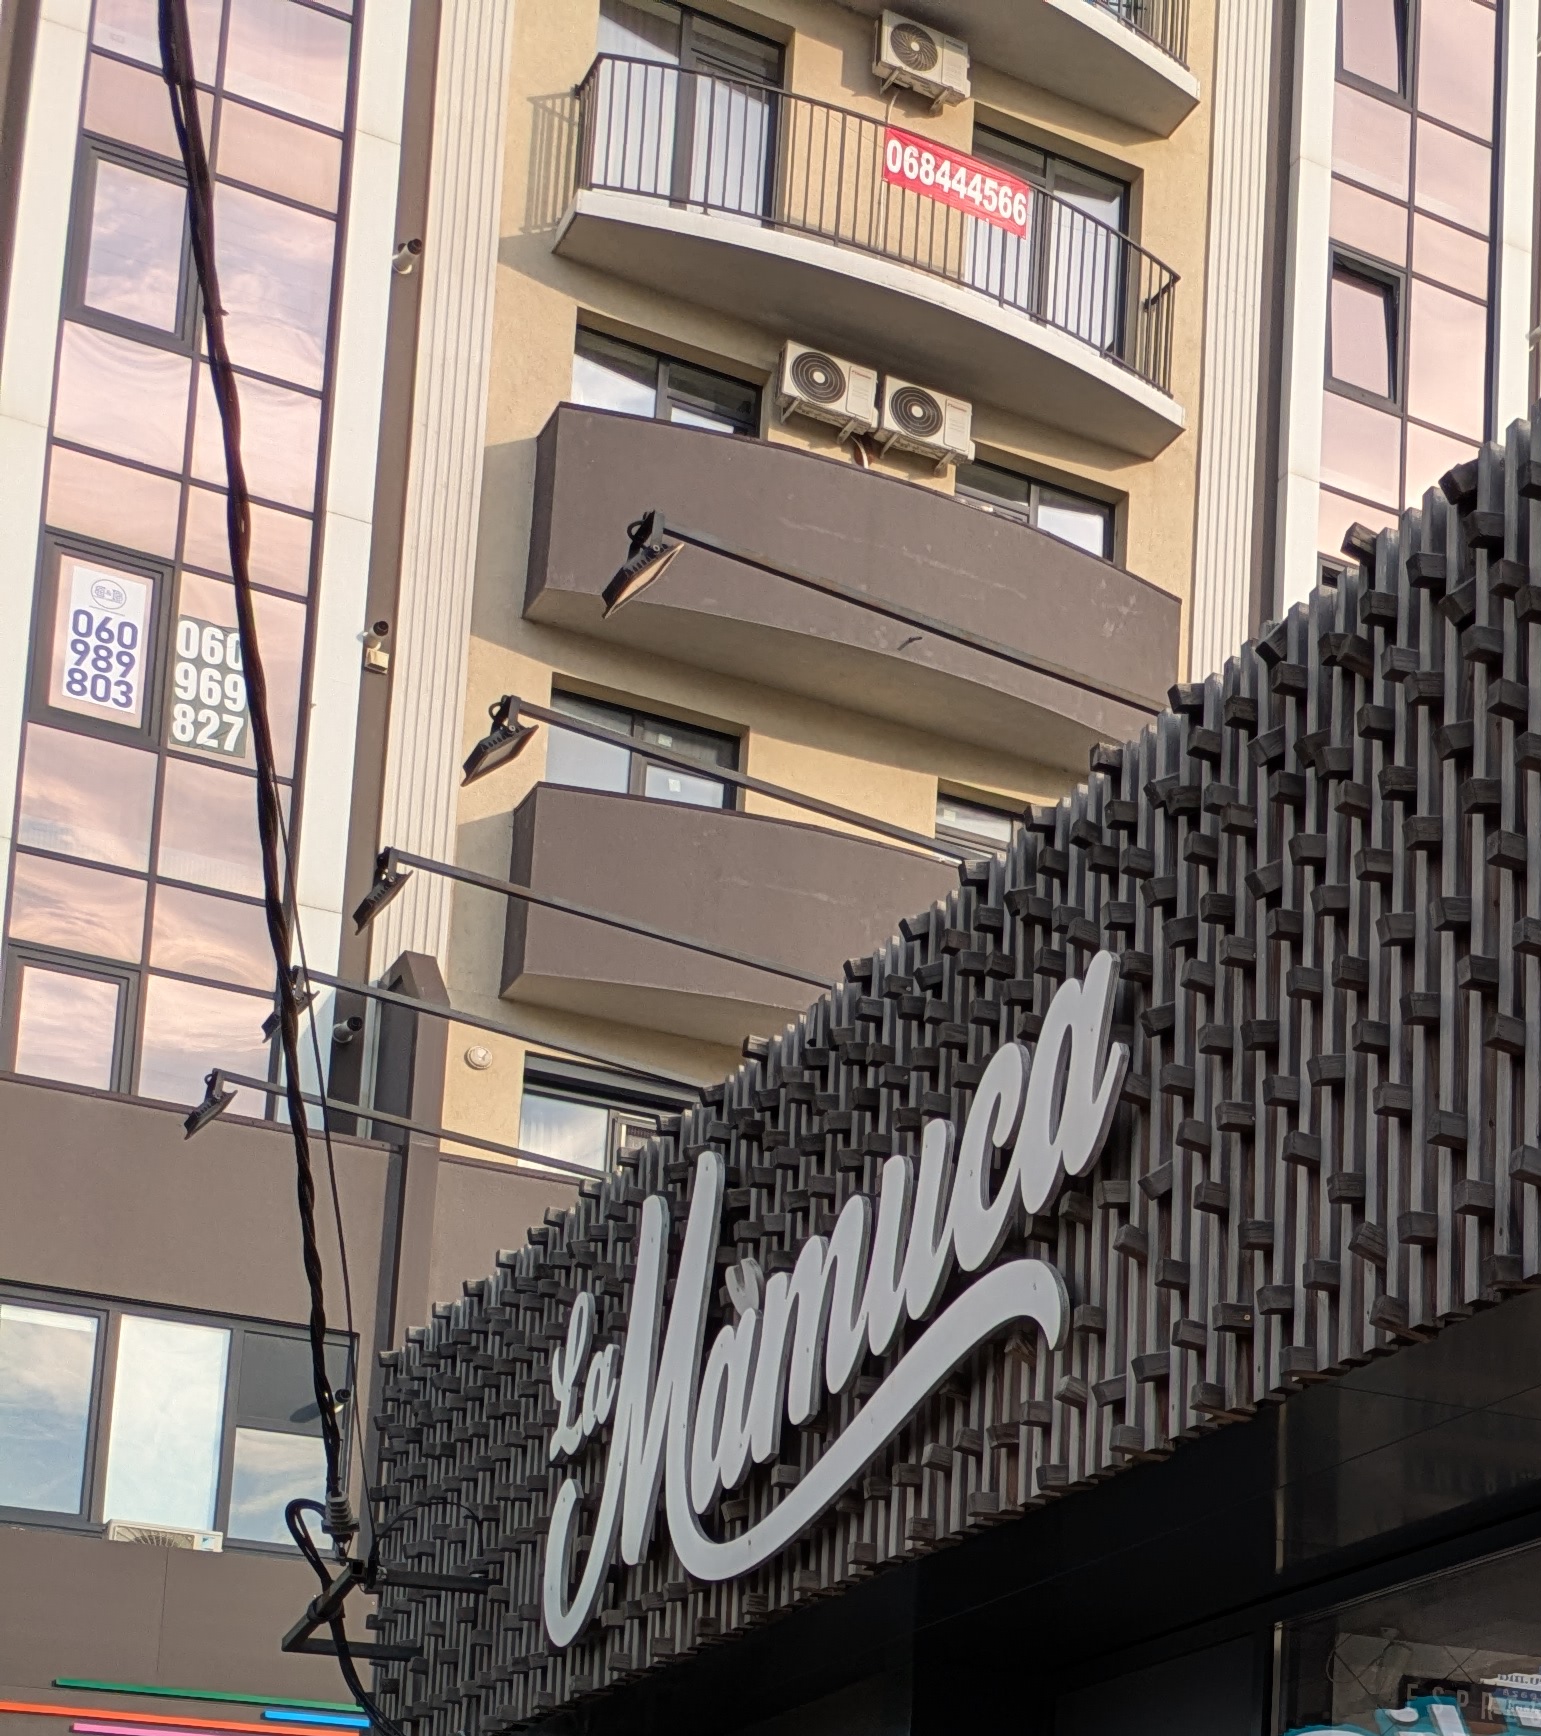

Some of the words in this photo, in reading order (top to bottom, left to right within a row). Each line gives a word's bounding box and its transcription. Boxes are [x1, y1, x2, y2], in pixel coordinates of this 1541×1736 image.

[885, 139, 1027, 226] 068444566
[71, 608, 139, 651] 060
[175, 619, 244, 671] 060
[69, 637, 136, 679] 989
[65, 666, 134, 709] 803
[174, 661, 247, 713] 969
[171, 702, 245, 753] 827
[549, 1291, 620, 1464] La
